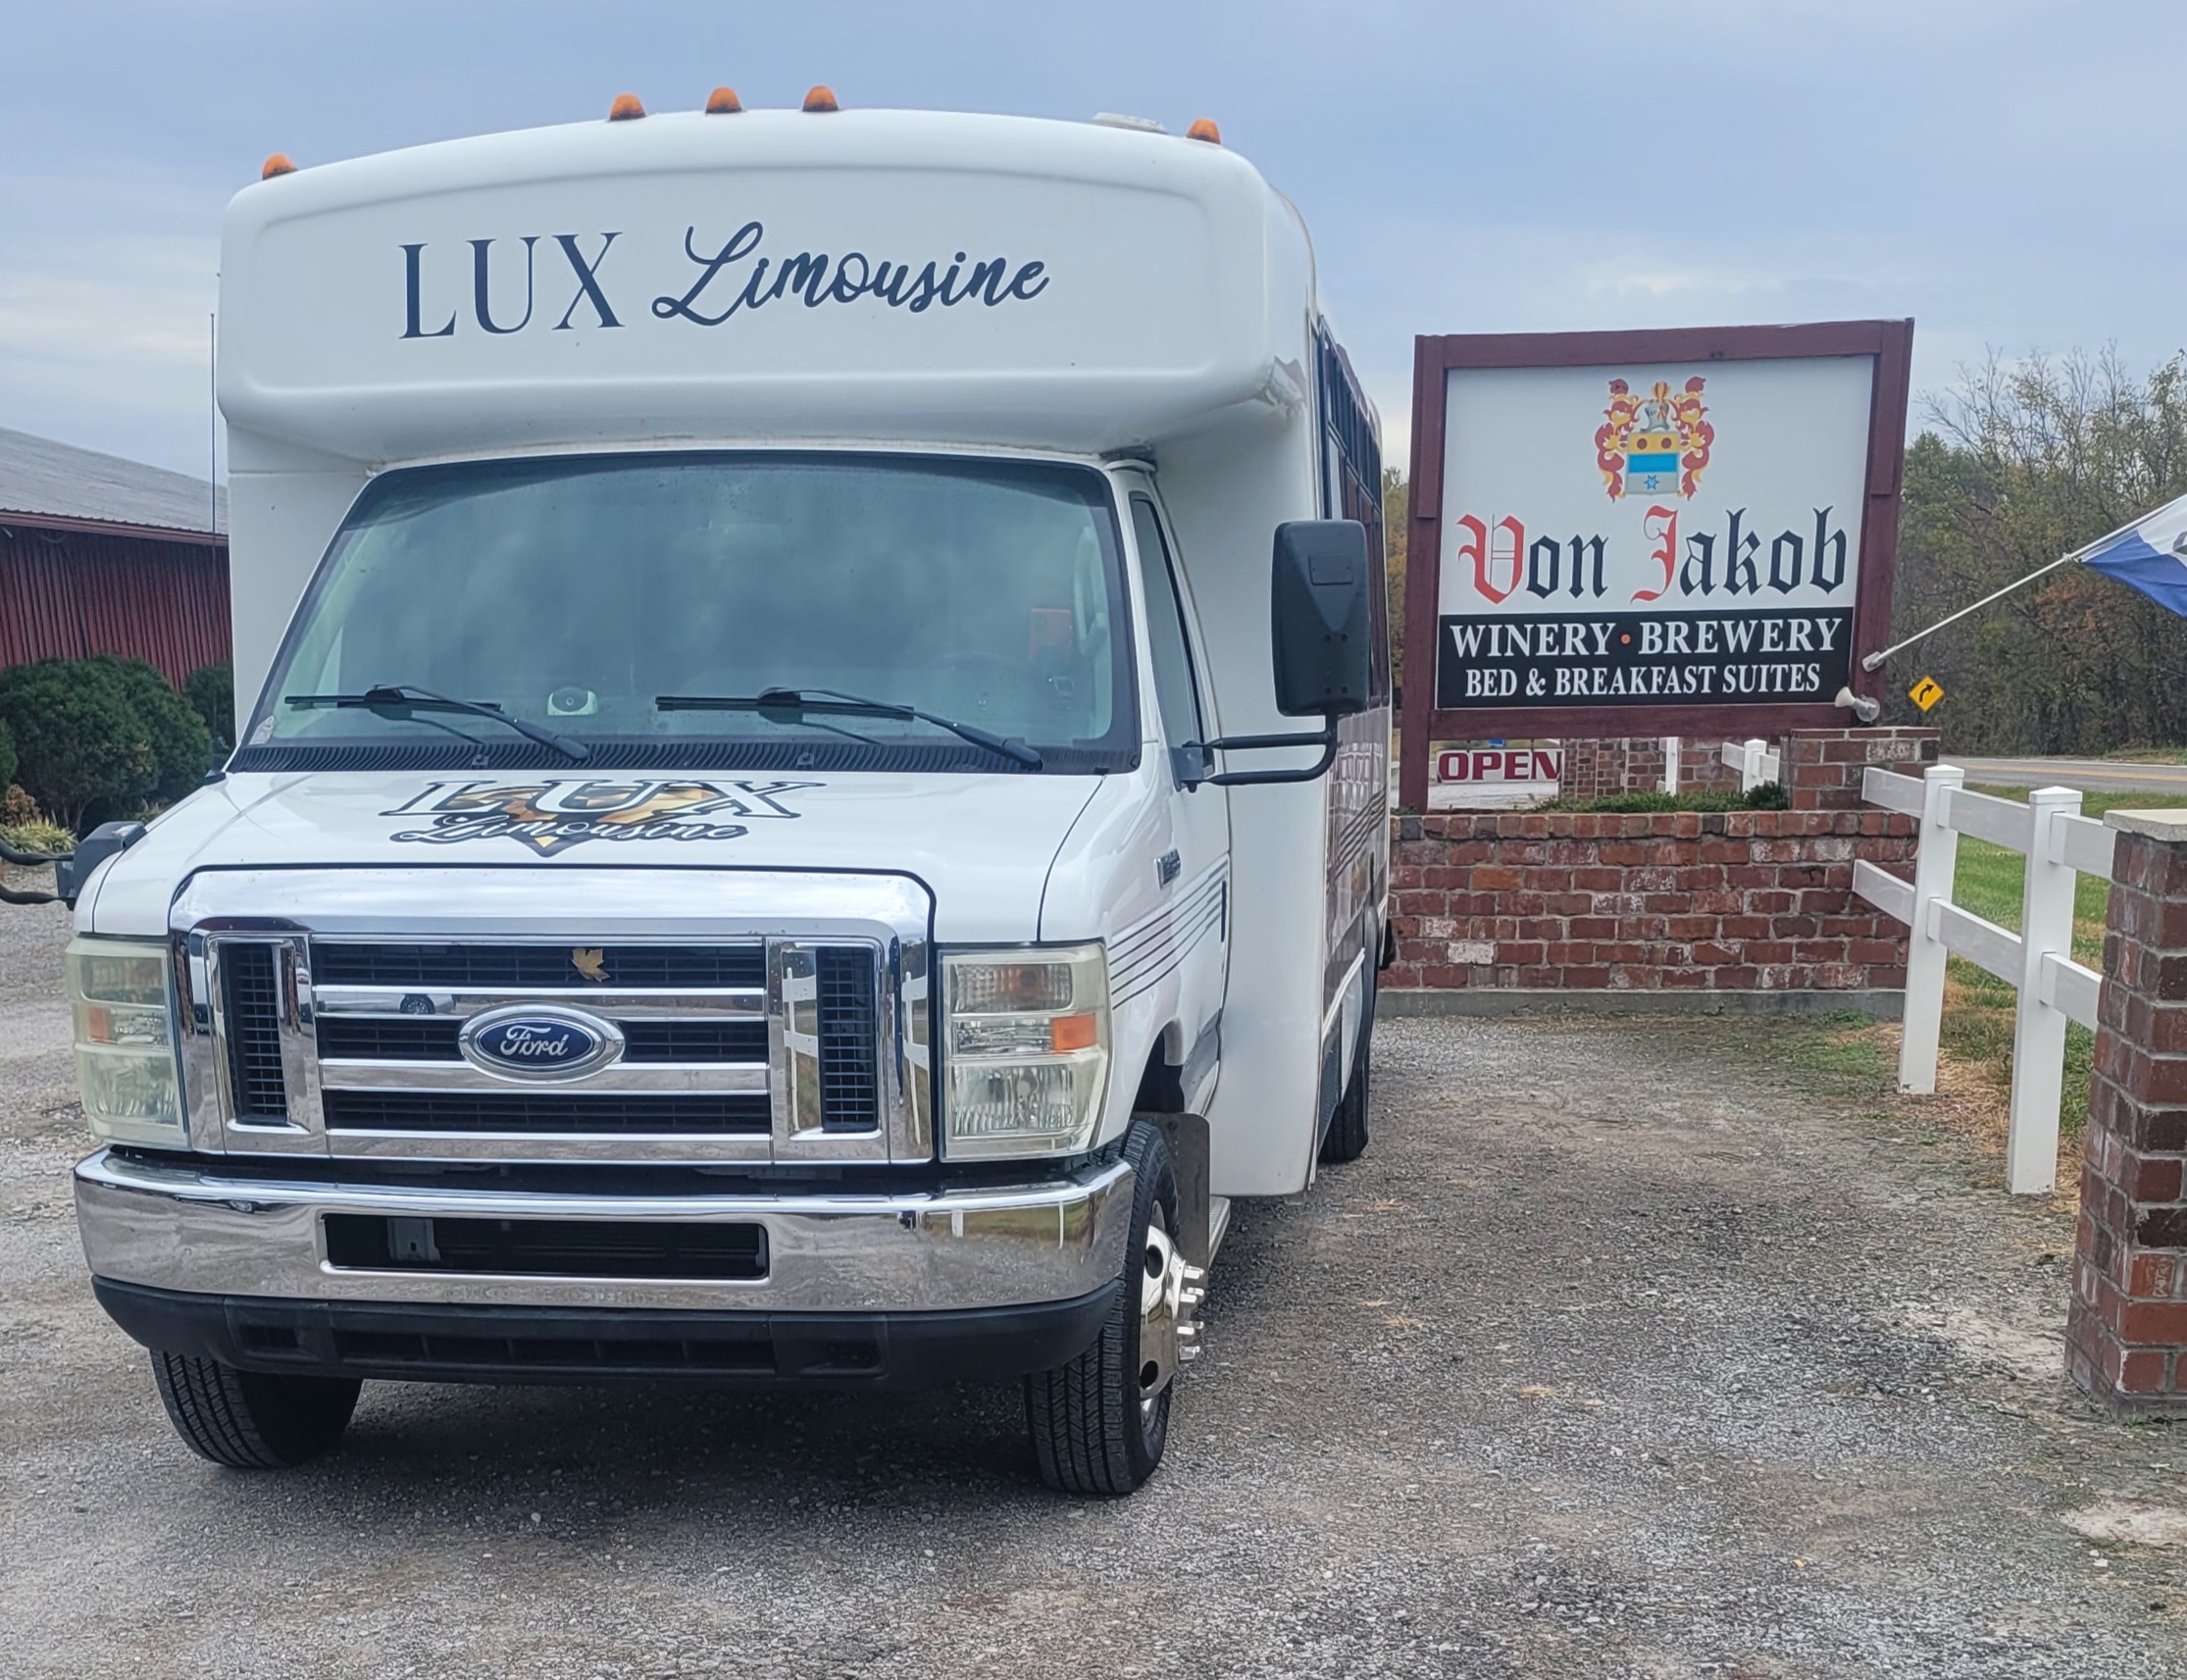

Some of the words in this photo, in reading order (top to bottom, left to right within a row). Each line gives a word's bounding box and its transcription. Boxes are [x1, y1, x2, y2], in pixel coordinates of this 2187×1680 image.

[397, 231, 626, 339] LUX
[651, 222, 1051, 327] Limousine
[1456, 513, 1610, 605] Von
[1629, 504, 1848, 605] Jakob
[1450, 622, 1616, 658] WINERY
[1638, 618, 1844, 655] BREWERY
[1464, 669, 1518, 697] BED
[1525, 669, 1547, 695] &
[1553, 665, 1716, 696] BREAKFAST
[1722, 663, 1821, 693] SUITES
[1438, 751, 1562, 781] OPEN
[378, 780, 828, 818] LUX
[389, 814, 748, 843] Limousine
[499, 1025, 570, 1056] Ford
